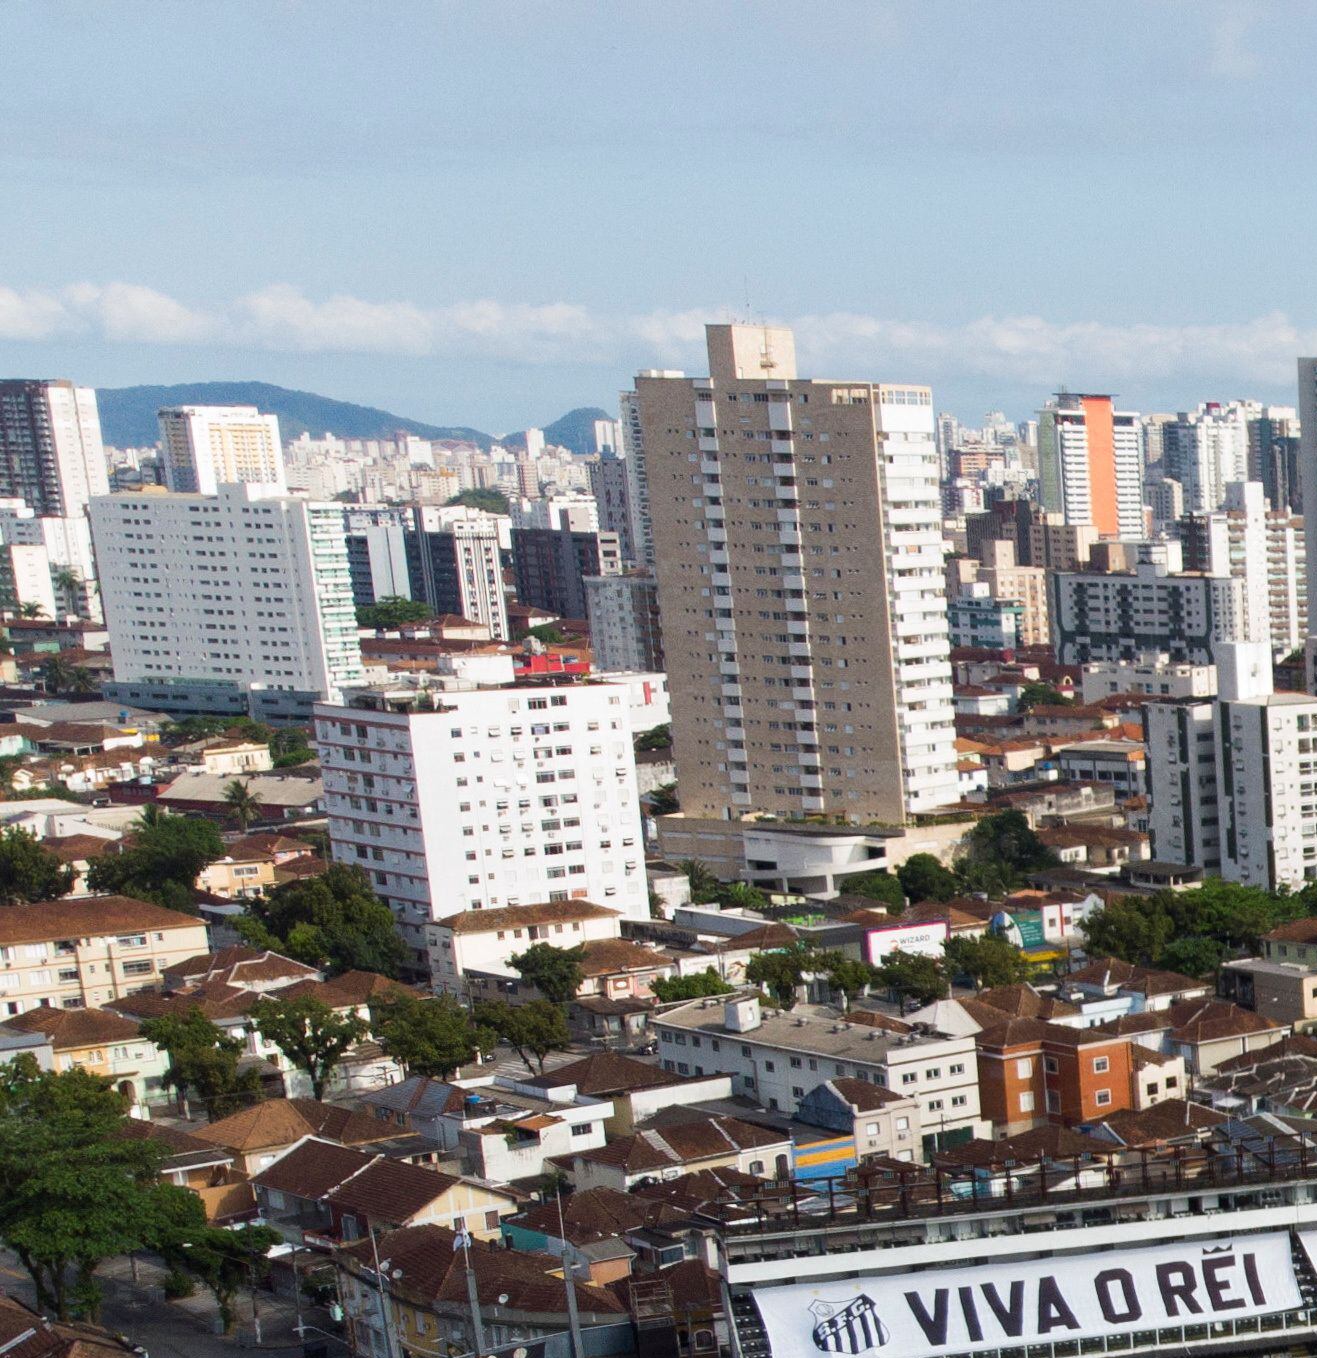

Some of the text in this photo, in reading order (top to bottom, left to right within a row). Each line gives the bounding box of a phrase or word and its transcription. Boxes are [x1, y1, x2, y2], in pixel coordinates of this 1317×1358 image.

[900, 935, 930, 945] WIZARD
[904, 1252, 1266, 1346] VIVA O REI
